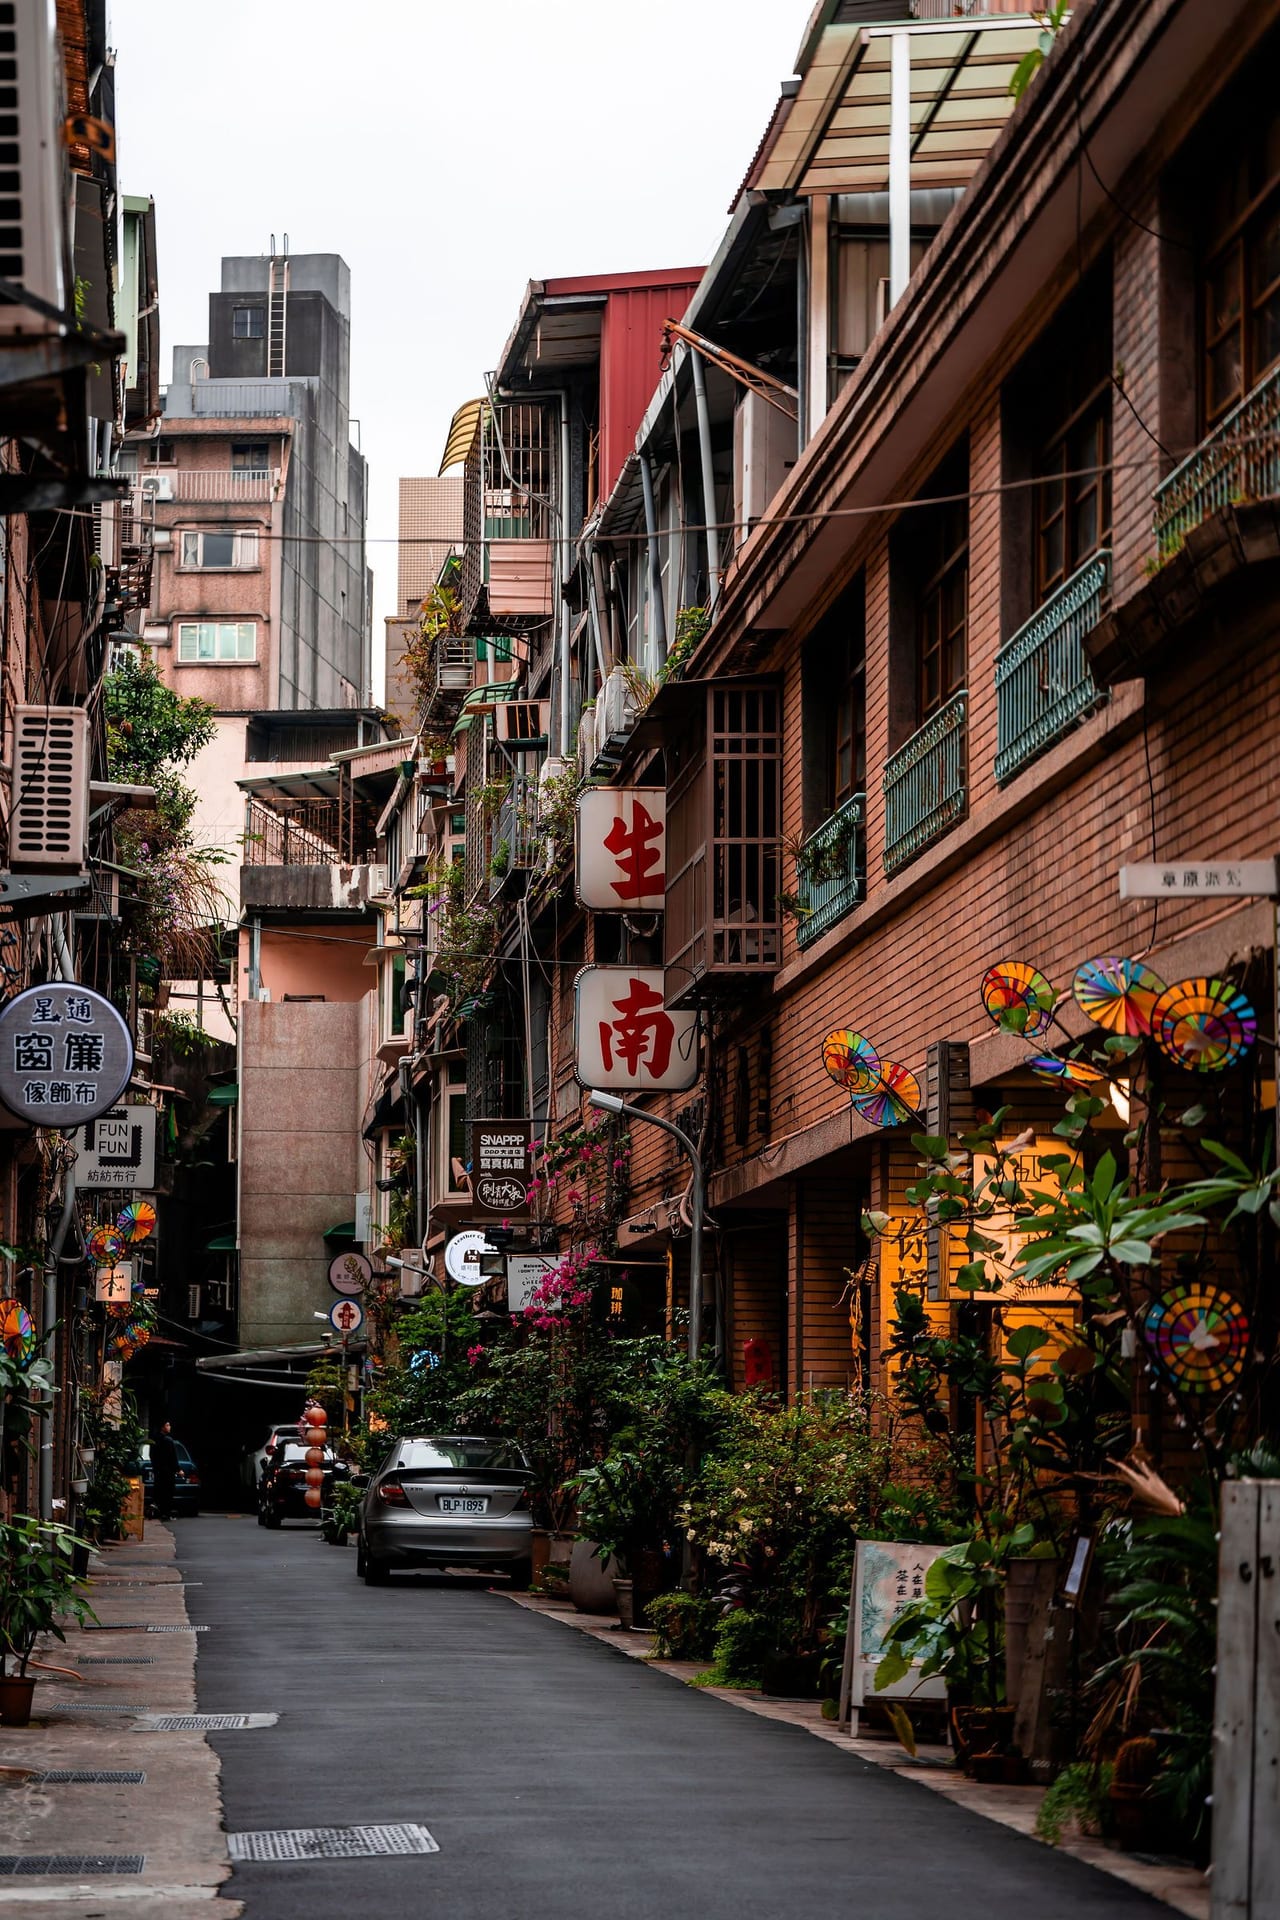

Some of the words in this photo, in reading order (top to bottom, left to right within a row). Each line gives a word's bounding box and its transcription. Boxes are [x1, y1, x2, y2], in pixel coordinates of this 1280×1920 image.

[598, 977, 675, 1080] 南
[24, 1081, 98, 1105] 傢飾布
[98, 1123, 128, 1137] FUN
[98, 1140, 128, 1154] FUN
[480, 1134, 525, 1146] SNAPPP
[87, 1169, 137, 1183] 紡紡布行
